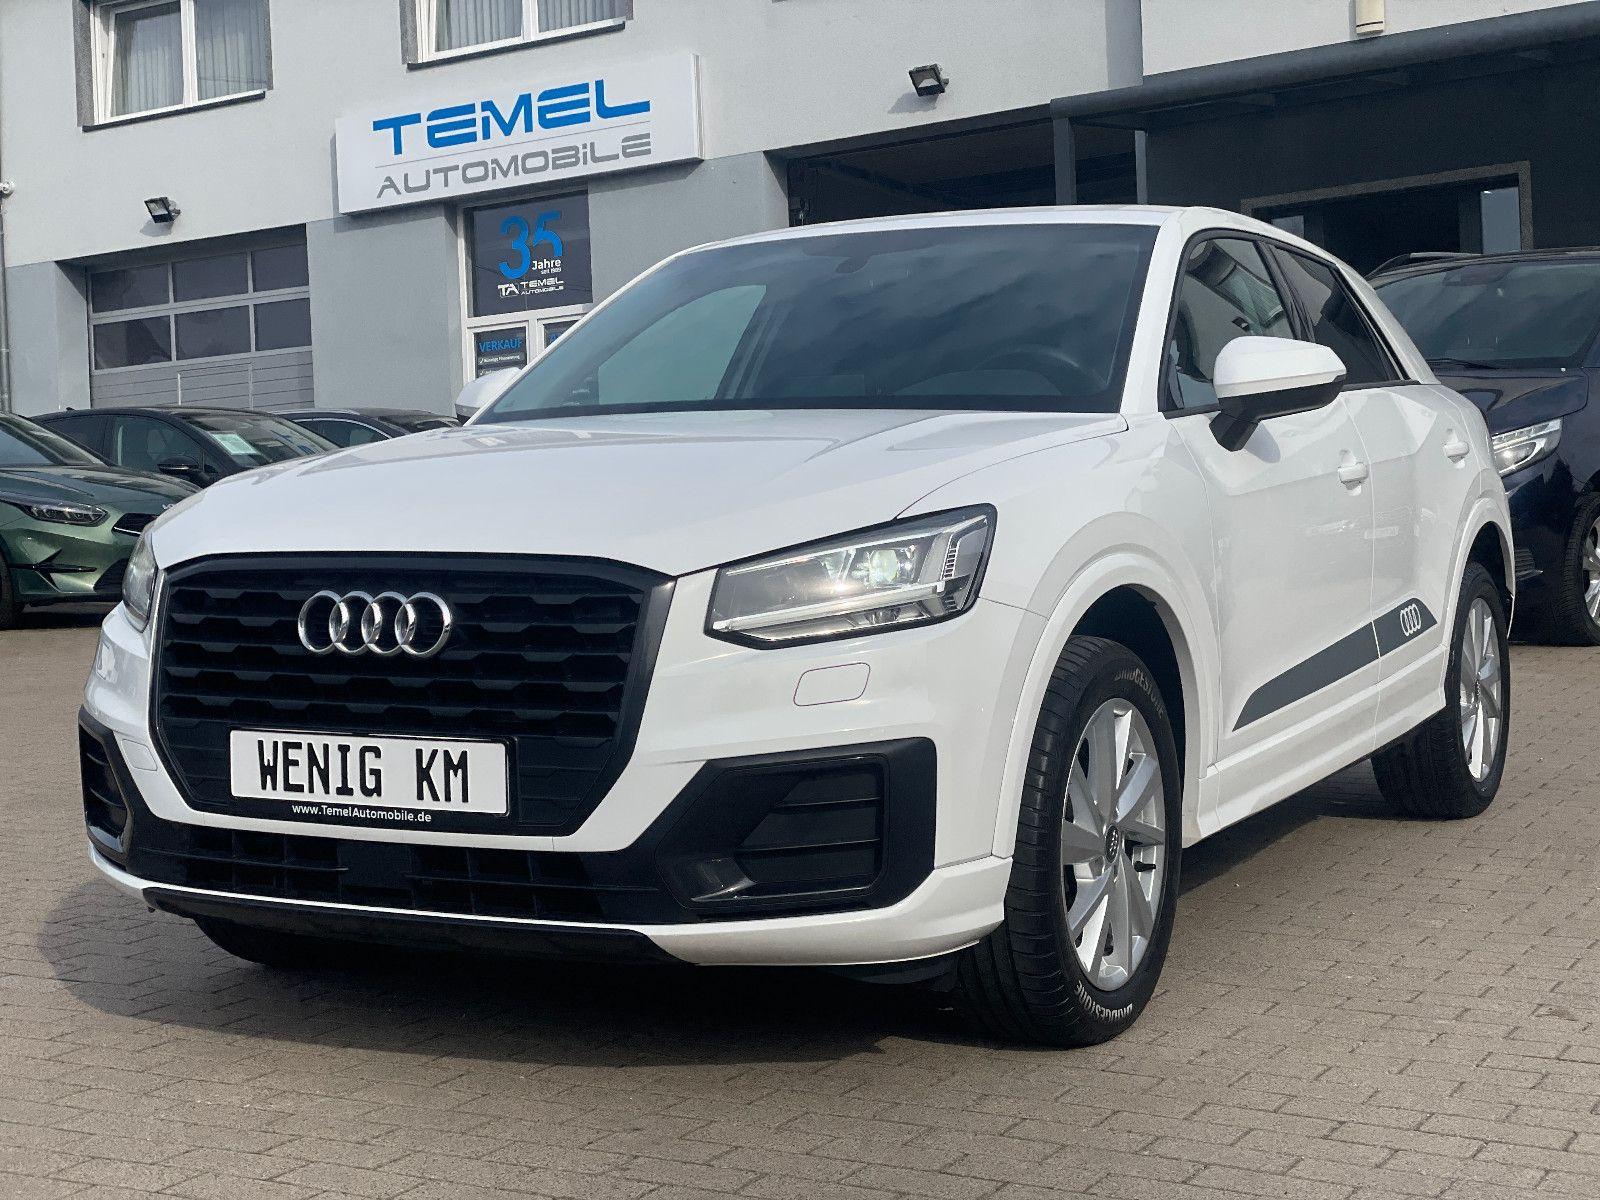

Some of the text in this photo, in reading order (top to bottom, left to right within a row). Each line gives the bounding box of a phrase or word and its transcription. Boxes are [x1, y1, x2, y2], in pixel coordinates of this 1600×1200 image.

[372, 78, 651, 156] TEMEL
[498, 210, 564, 280] 35
[532, 258, 562, 271] Jahre
[520, 277, 564, 289] TEMEL
[478, 337, 523, 353] VERKAUF
[257, 739, 470, 803] WENIG KM
[291, 804, 433, 822] www.TemelAutomobile.de
